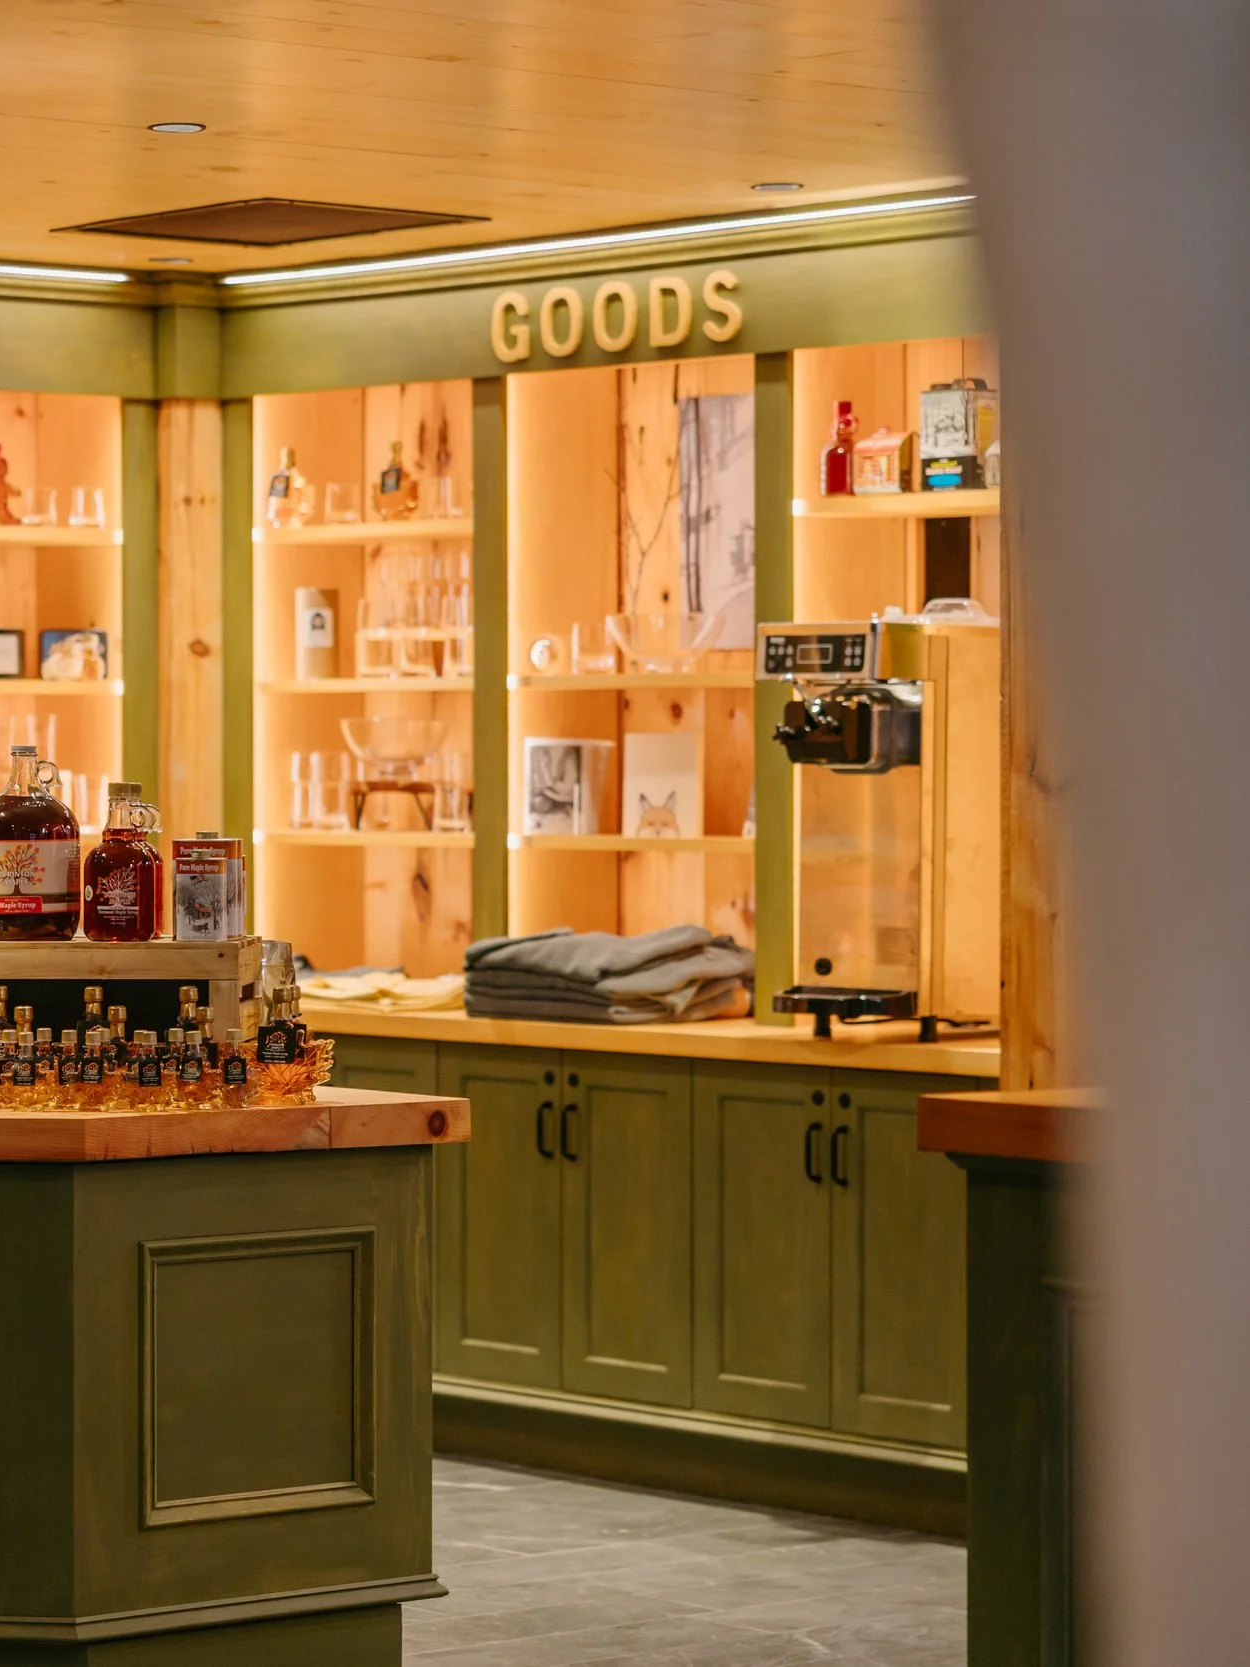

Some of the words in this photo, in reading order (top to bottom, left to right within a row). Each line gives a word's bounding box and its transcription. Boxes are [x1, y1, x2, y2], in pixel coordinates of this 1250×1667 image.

[490, 269, 743, 363] GOODS
[190, 864, 204, 872] Maple
[204, 864, 219, 872] Syrup
